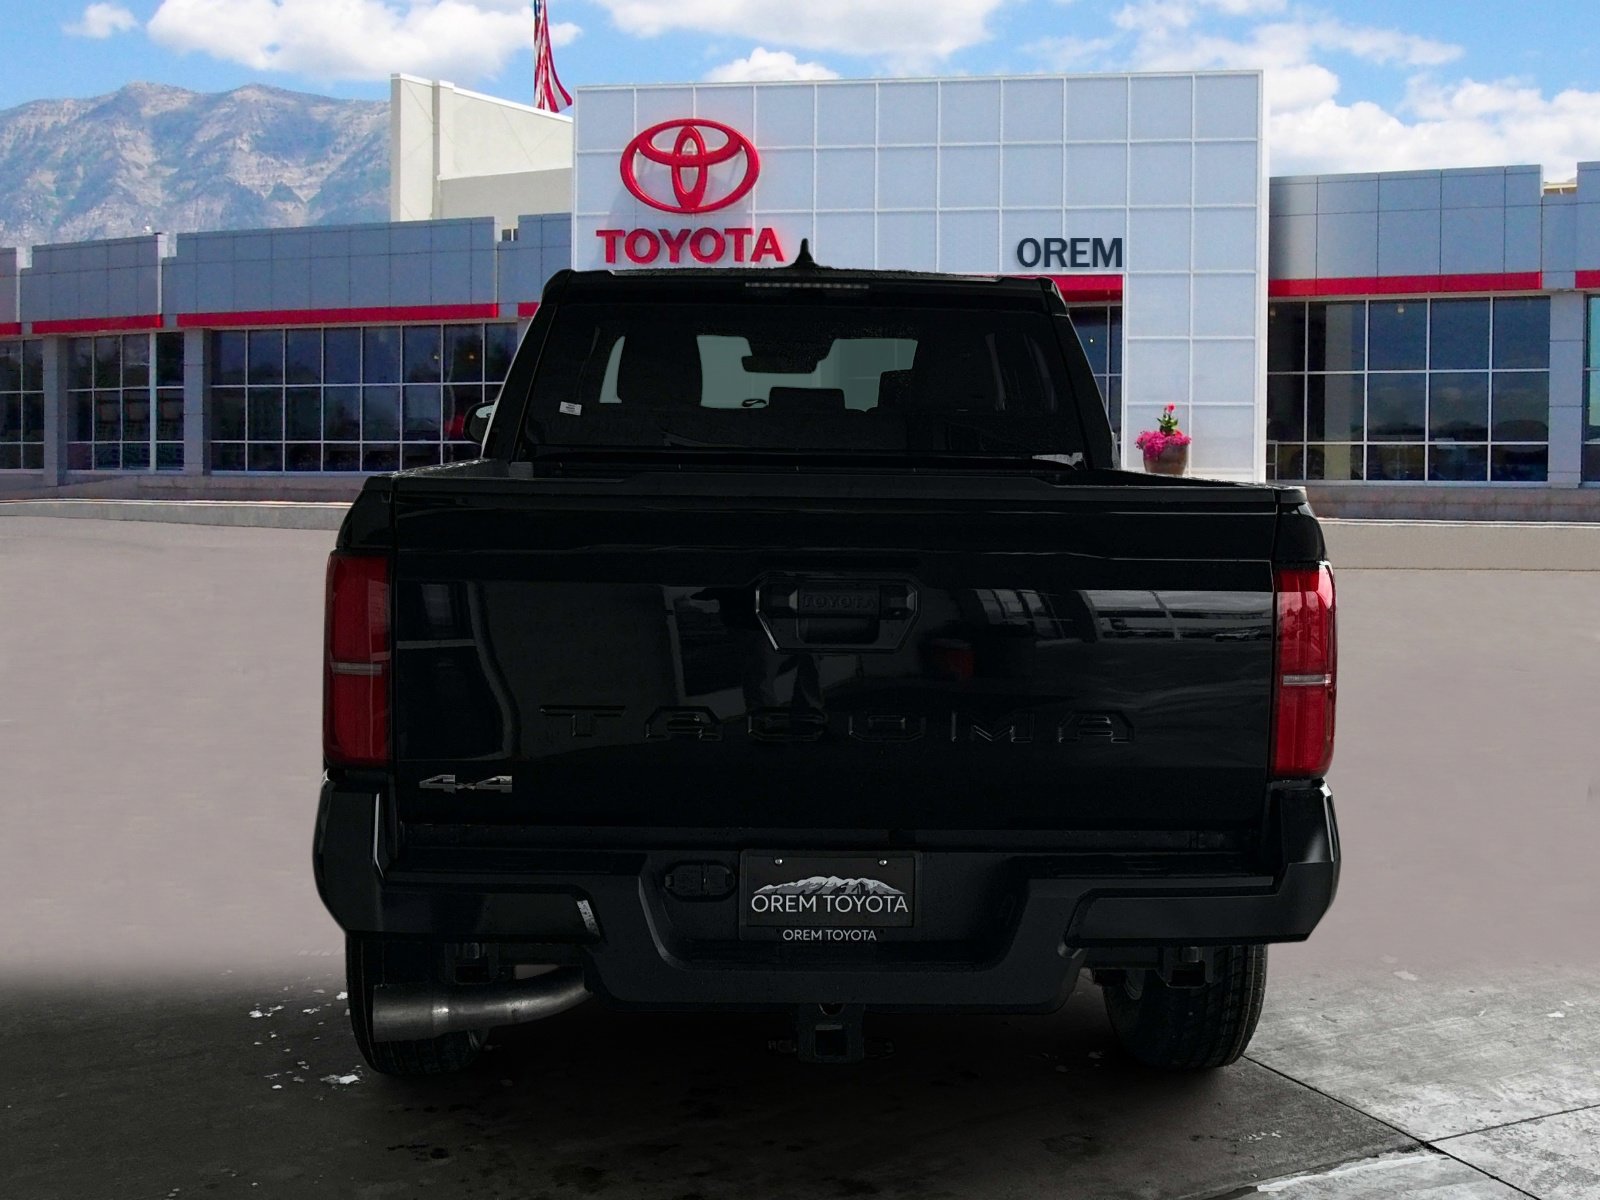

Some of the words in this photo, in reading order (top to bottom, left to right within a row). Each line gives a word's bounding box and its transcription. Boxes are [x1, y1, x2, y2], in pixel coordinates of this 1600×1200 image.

[596, 227, 784, 264] TOYOTA
[1016, 237, 1123, 268] OREM
[802, 592, 877, 609] TOYOTA
[539, 703, 1136, 744] TACOMA
[751, 894, 817, 913] OREM
[823, 894, 909, 913] TOYOTA
[782, 929, 822, 941] OREM
[826, 929, 877, 941] TOYOTA
